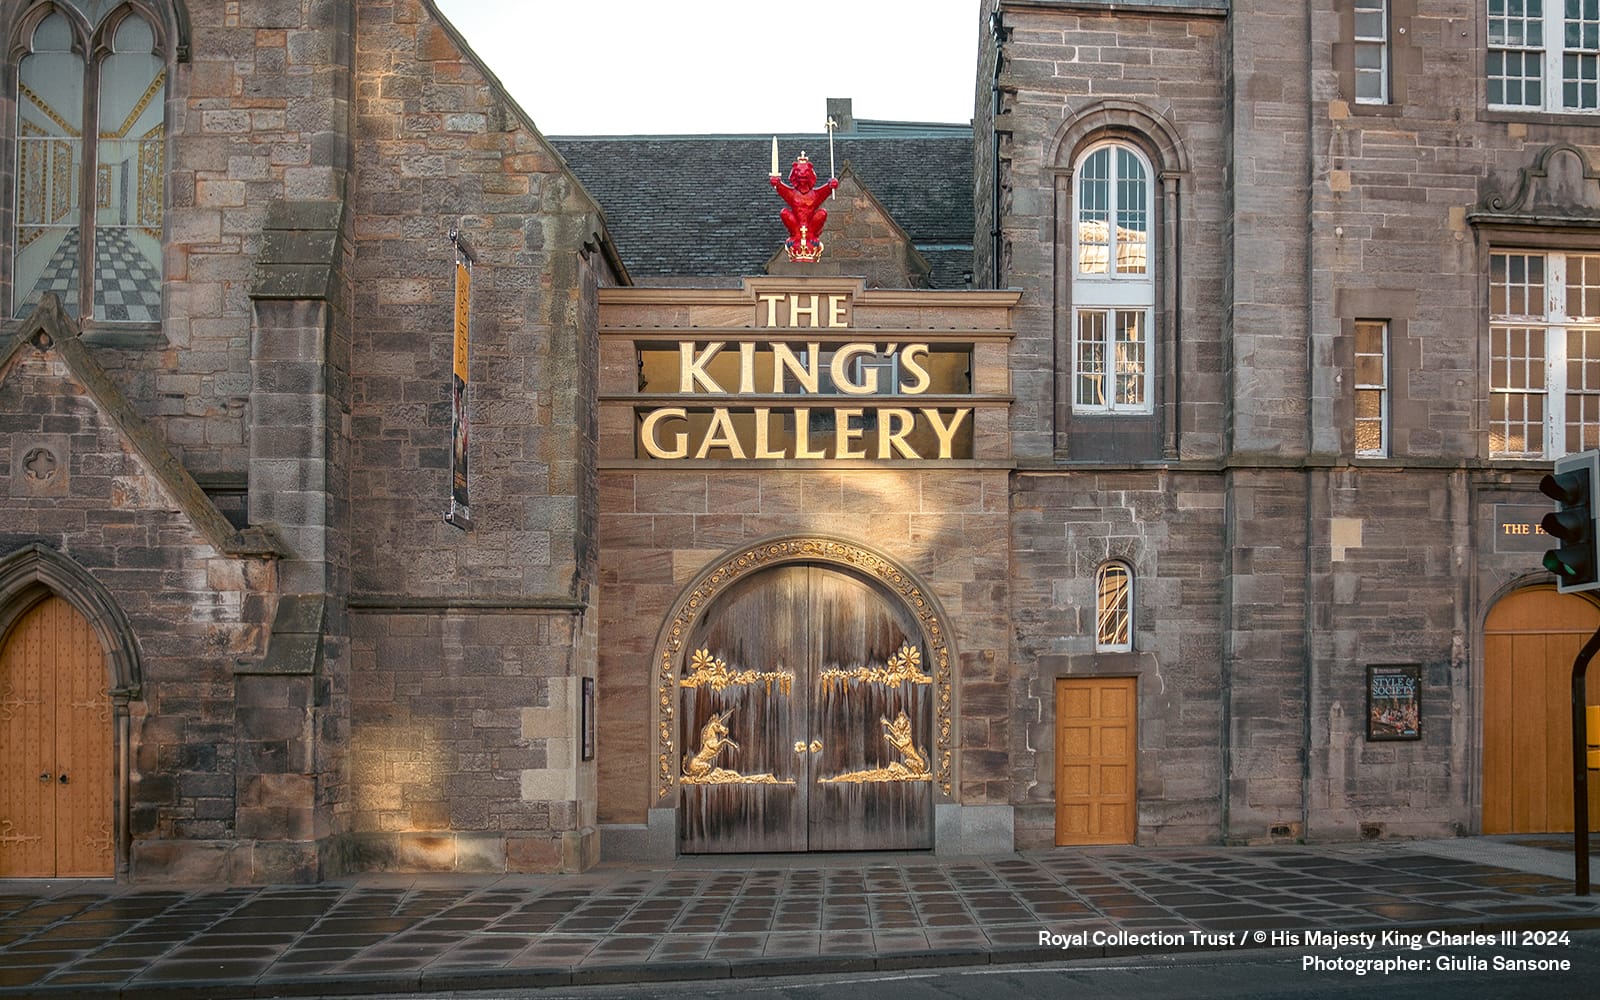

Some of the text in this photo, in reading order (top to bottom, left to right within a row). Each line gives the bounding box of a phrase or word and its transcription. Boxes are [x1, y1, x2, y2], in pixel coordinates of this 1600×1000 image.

[758, 294, 848, 328] THE
[678, 341, 931, 394] KING'S
[641, 407, 973, 460] GALLERY
[1502, 523, 1530, 535] THE
[1373, 677, 1405, 687] STYLE
[1373, 686, 1415, 695] SOCIETY
